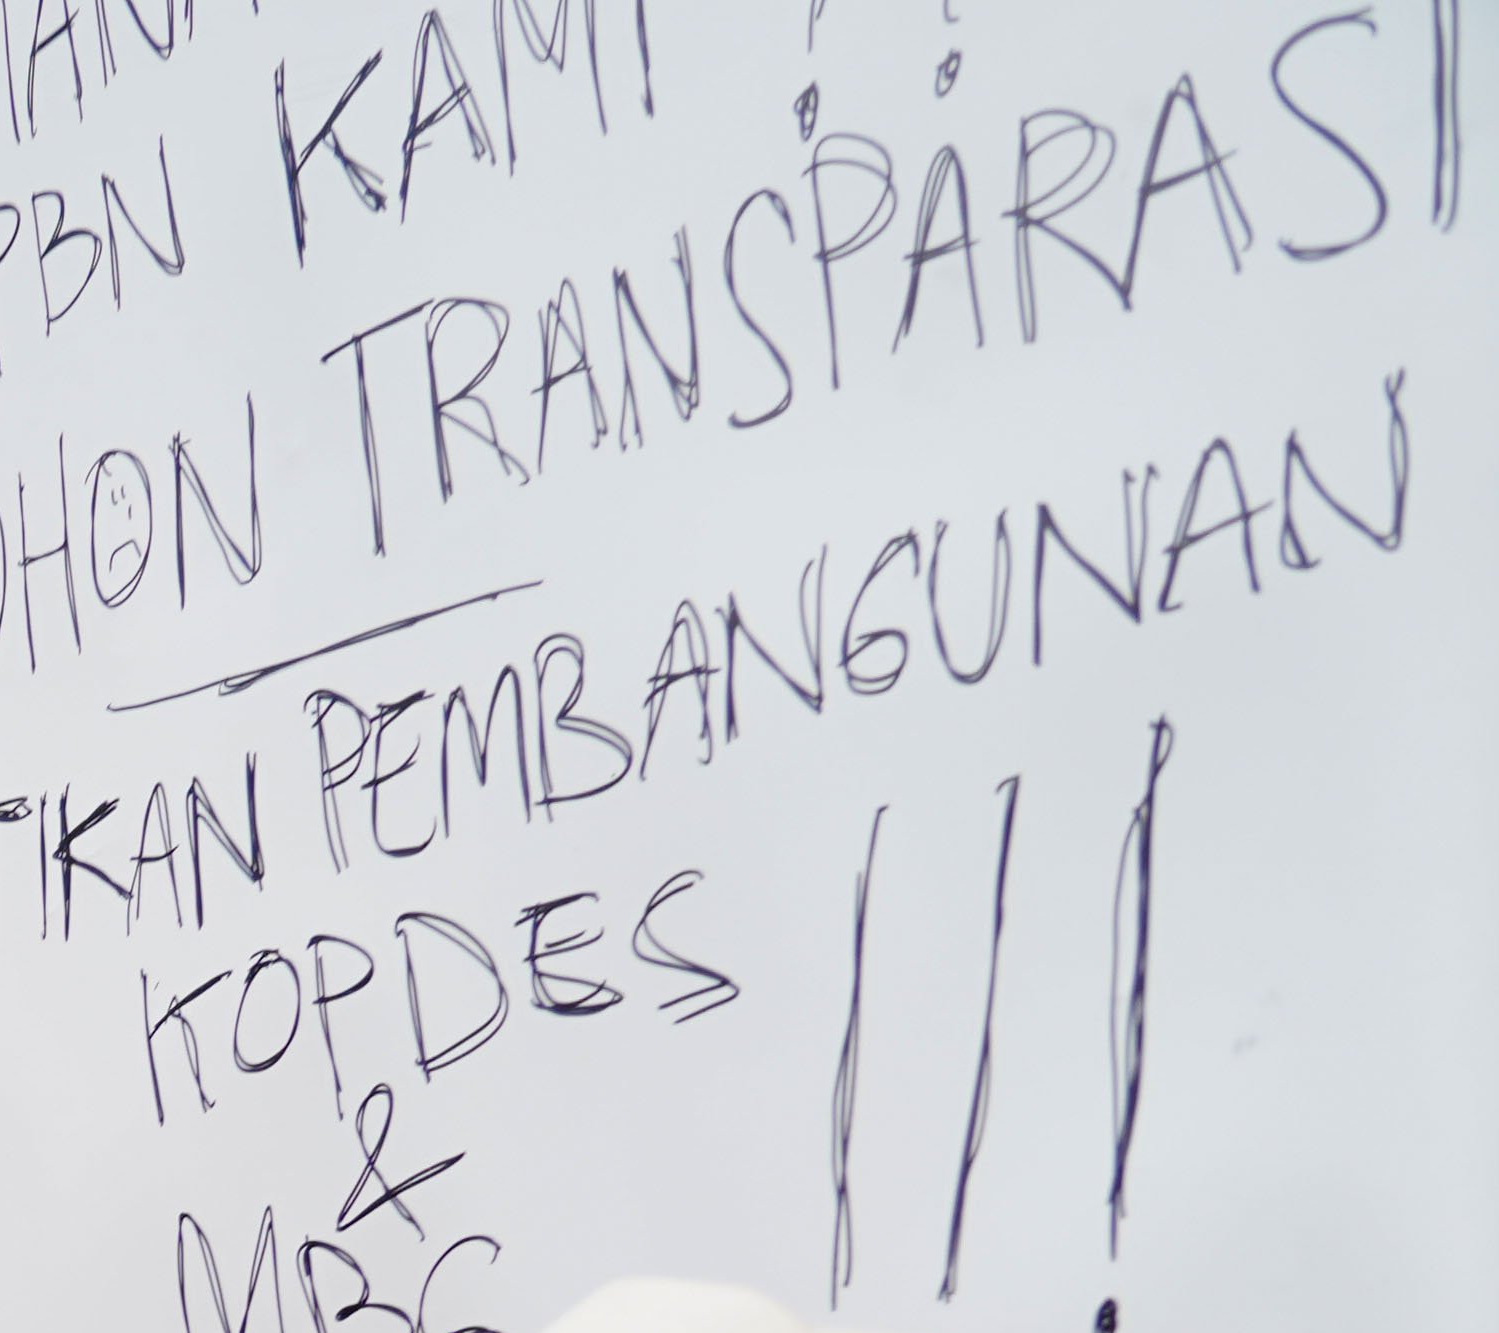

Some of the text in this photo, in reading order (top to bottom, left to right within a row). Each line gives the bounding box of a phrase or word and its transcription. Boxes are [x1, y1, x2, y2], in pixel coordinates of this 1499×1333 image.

[322, 0, 1461, 558] TRANSPARASI
[306, 368, 1408, 875] PEMBANGUNAN
[141, 868, 741, 1125] KOPDES
[337, 1083, 466, 1240] &
